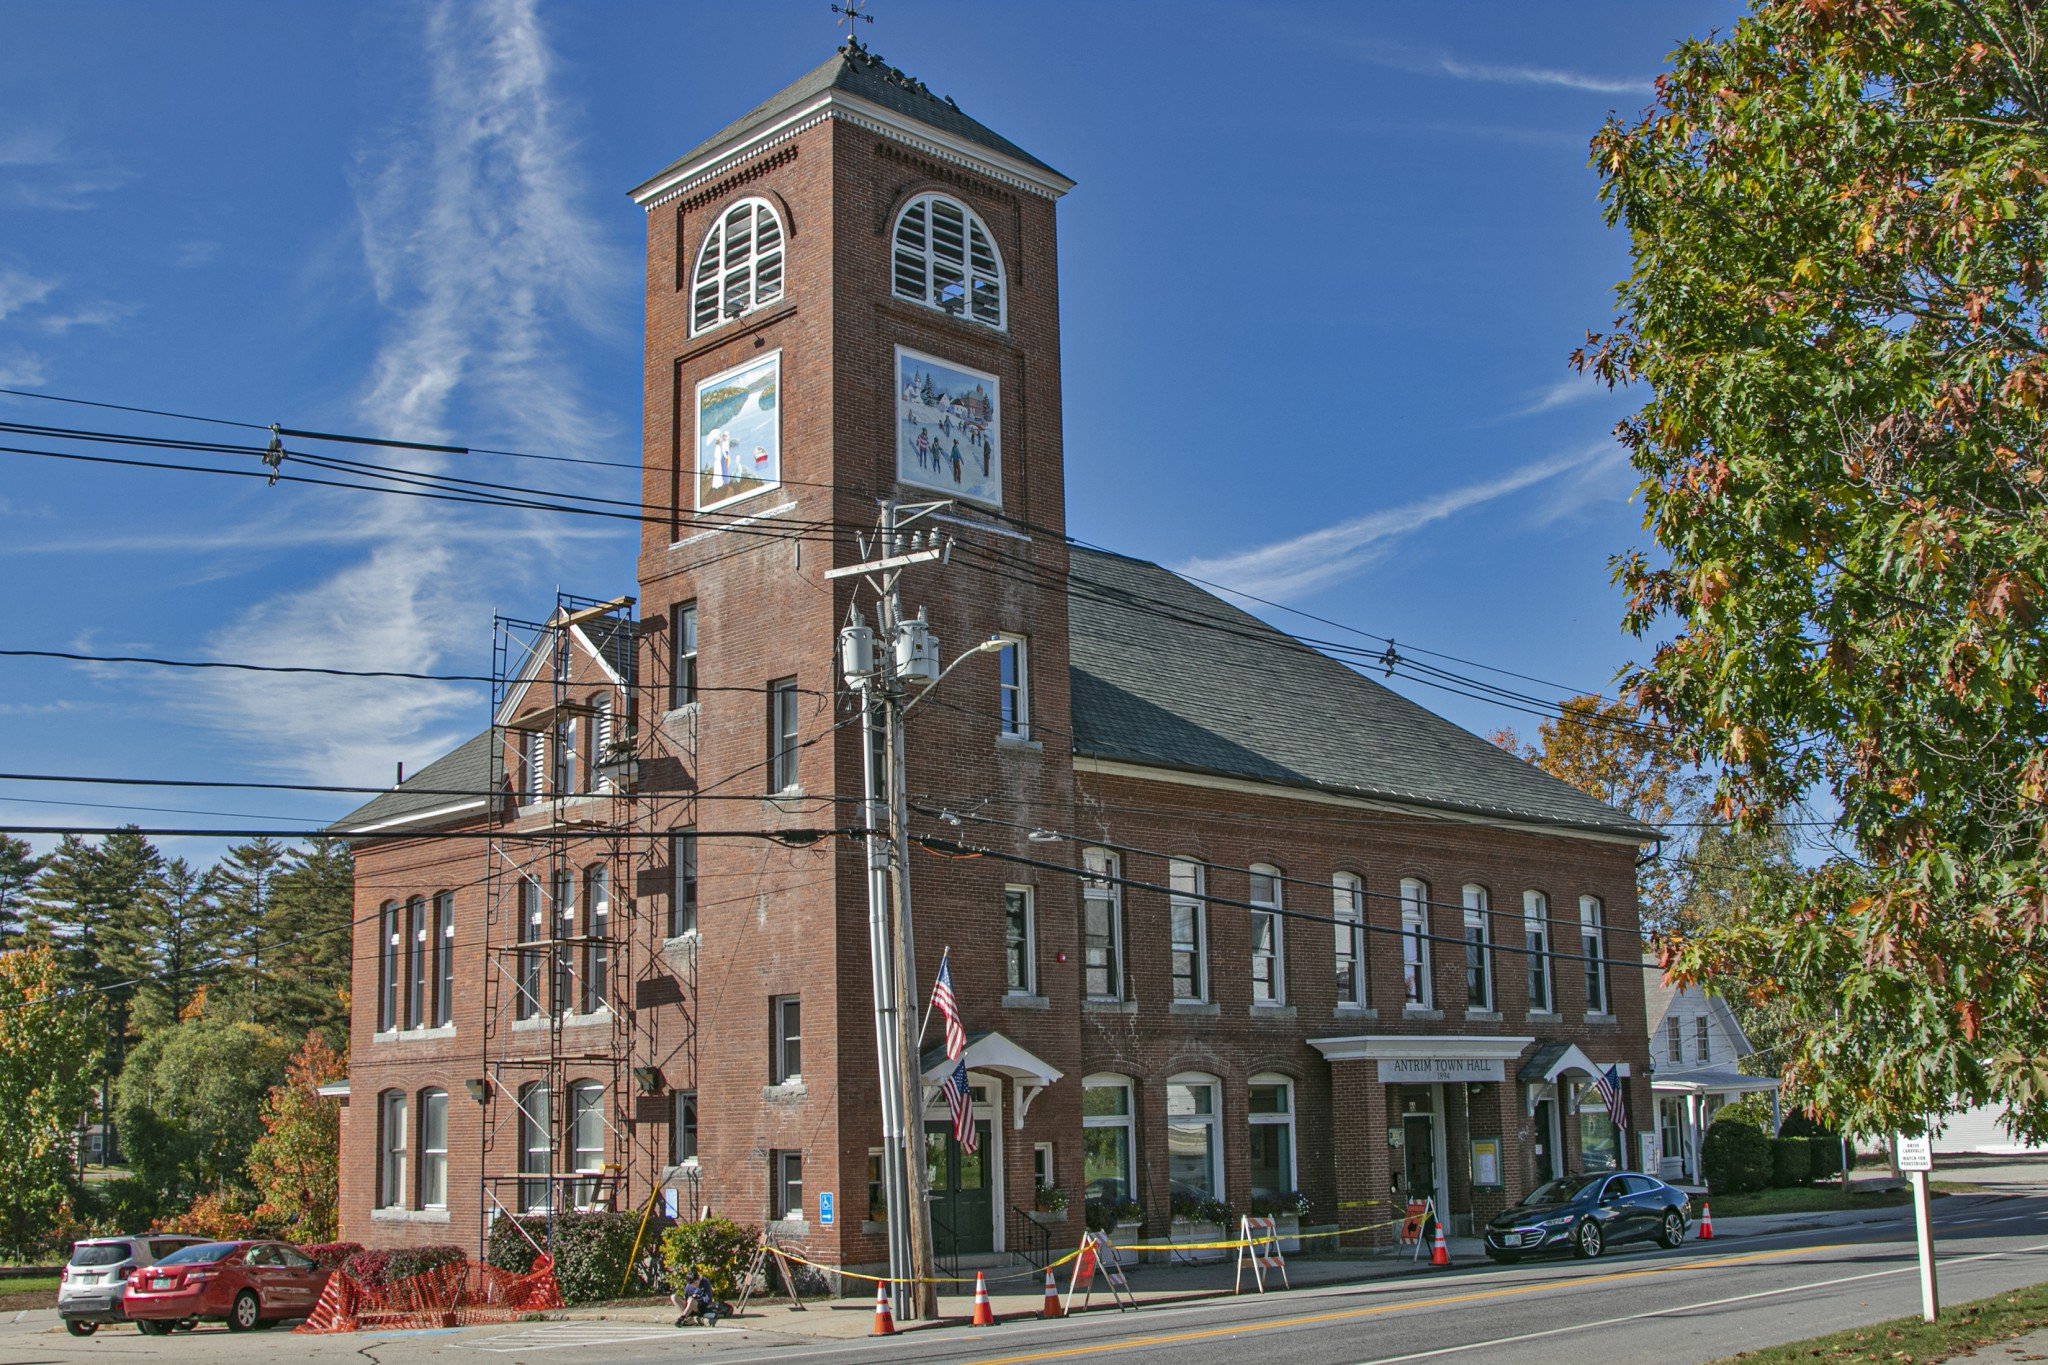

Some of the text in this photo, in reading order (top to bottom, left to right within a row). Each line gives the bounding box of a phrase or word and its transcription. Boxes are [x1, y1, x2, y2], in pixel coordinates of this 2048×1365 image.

[1394, 1059, 1491, 1072] ANTRIM TOWN HALL
[1437, 1072, 1450, 1080] 1894
